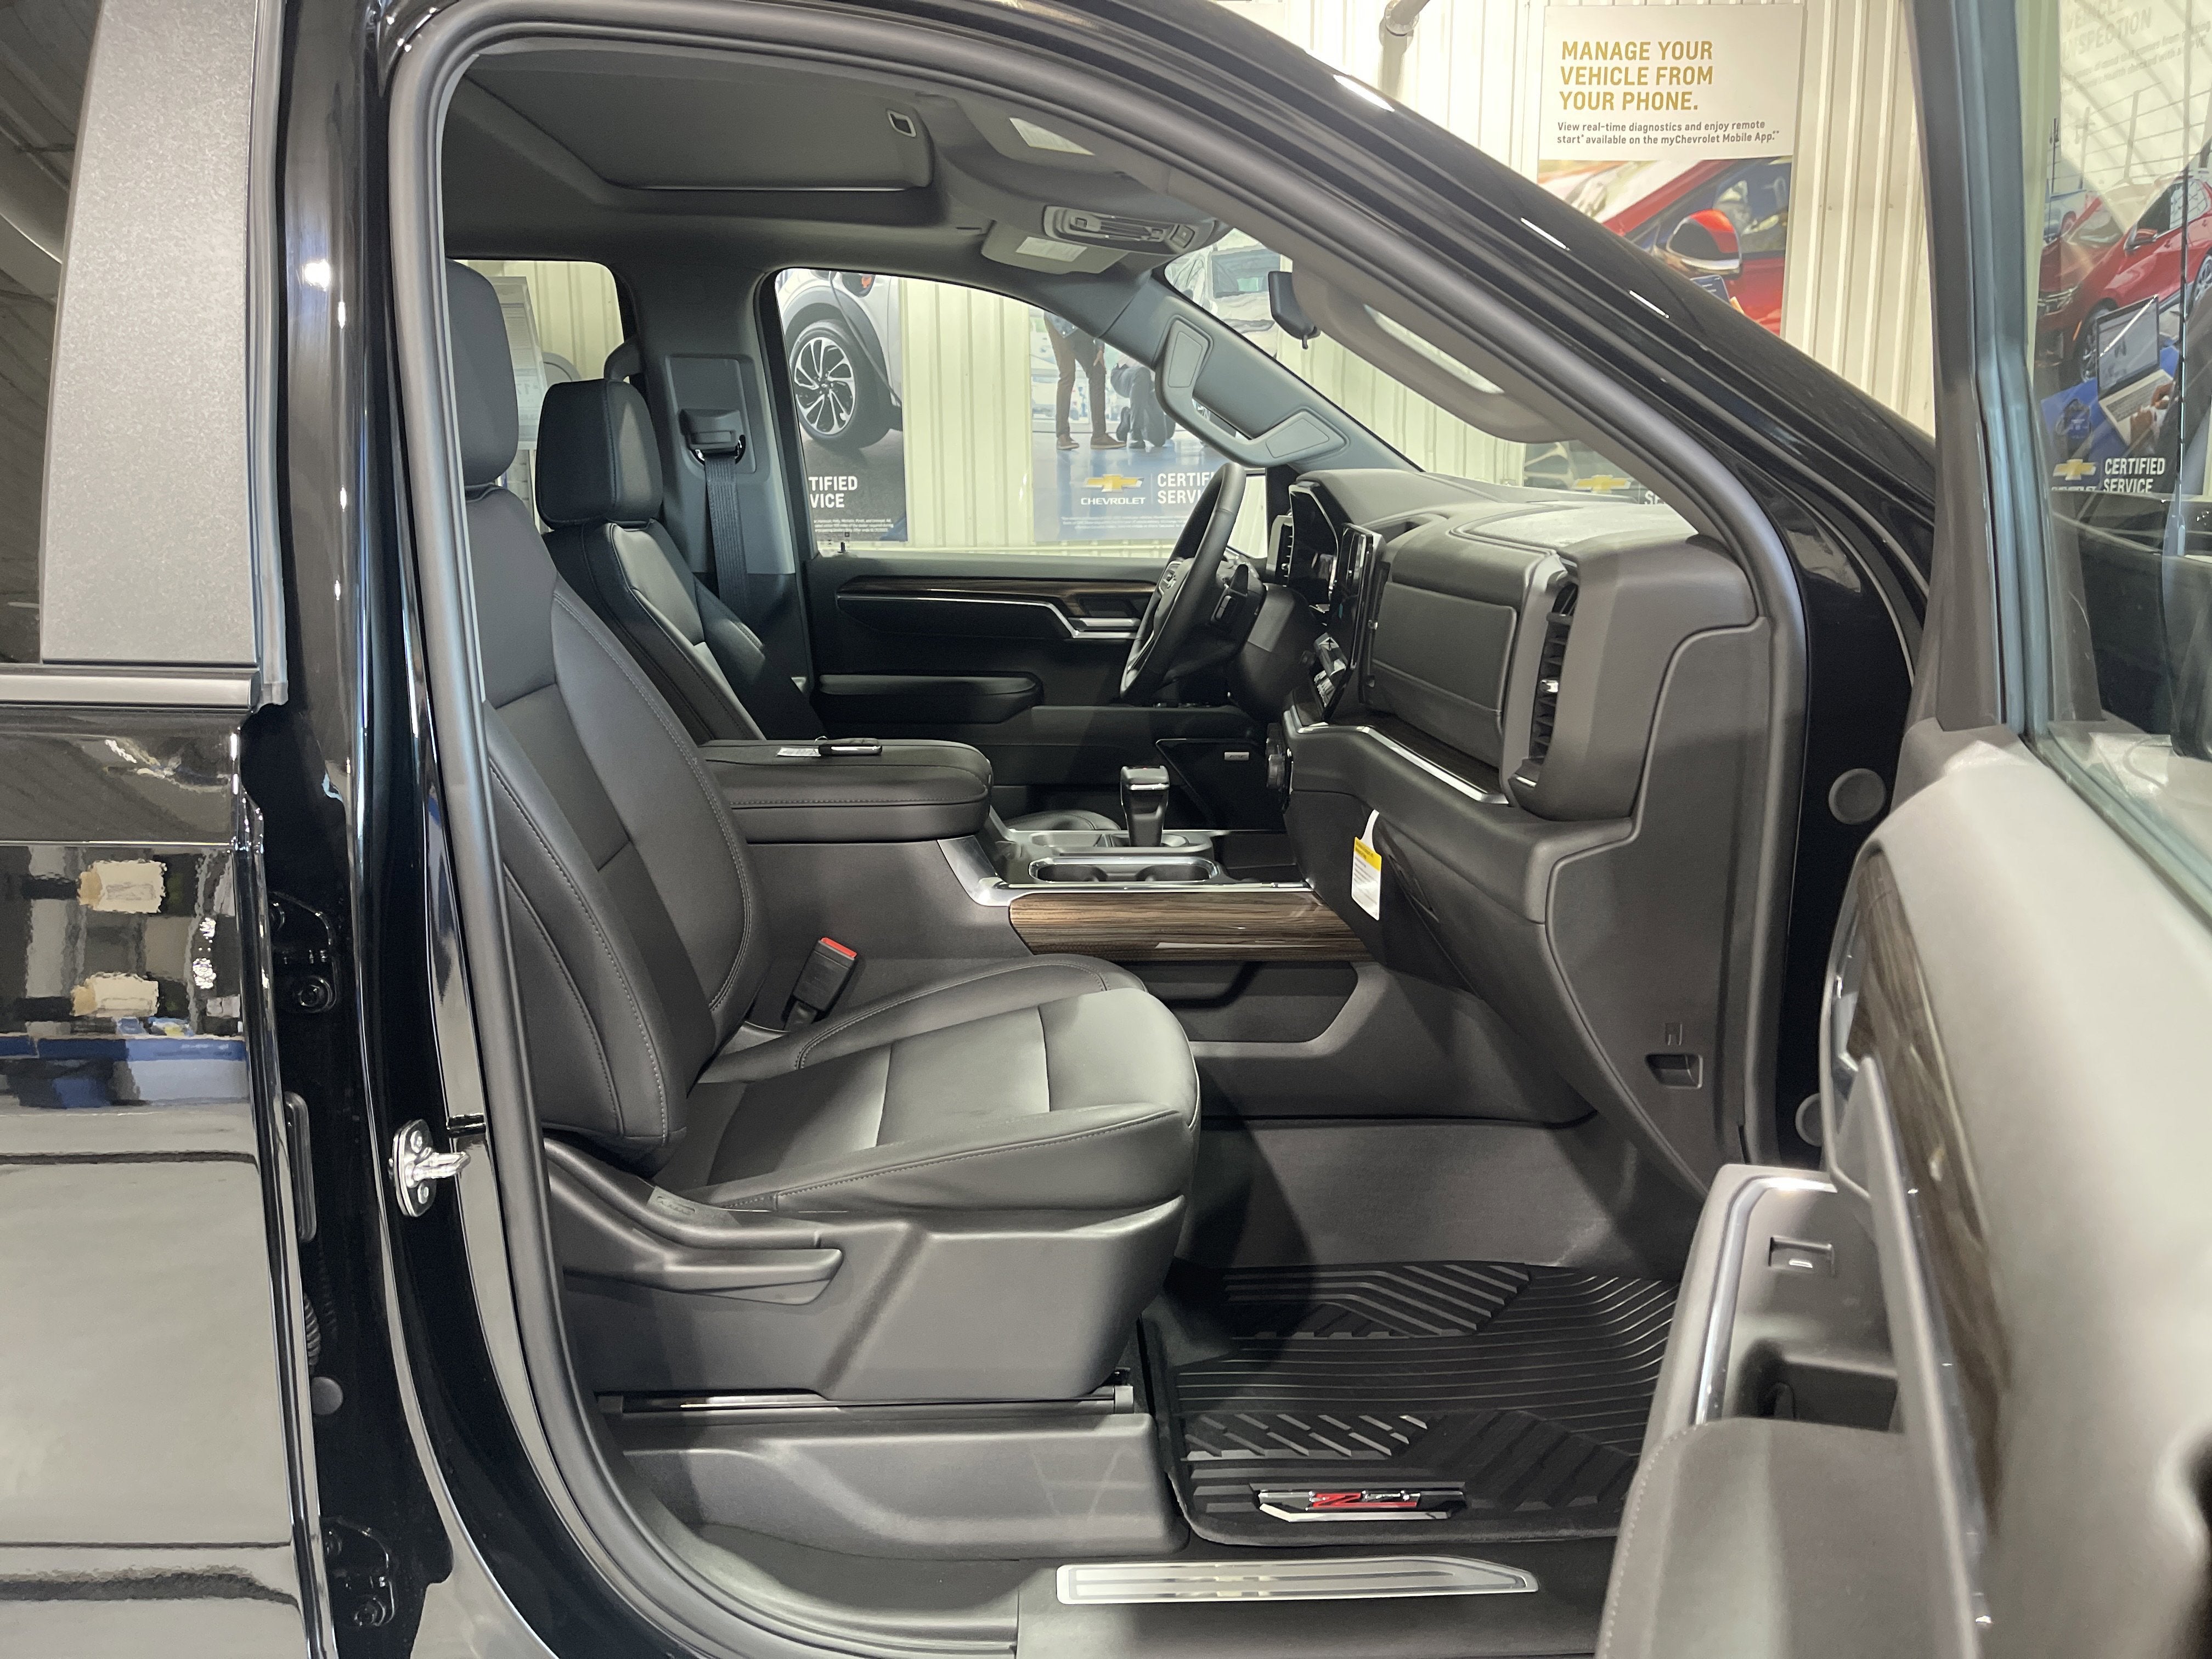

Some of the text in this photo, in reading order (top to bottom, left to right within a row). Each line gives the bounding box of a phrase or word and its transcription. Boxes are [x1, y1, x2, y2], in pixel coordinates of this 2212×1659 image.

[1562, 41, 1713, 60] MANAGE YOUR
[1560, 66, 1713, 86] VEHICLE FROM
[1559, 91, 1698, 110] YOUR PHONE.
[1558, 121, 1765, 133] View real-time diagnostics and enjoy remote
[1586, 135, 1627, 144] available
[1629, 136, 1640, 144] on
[1643, 135, 1658, 144] the
[1661, 134, 1720, 146] myChevrolet
[1723, 133, 1752, 143] Mobile
[2104, 458, 2165, 475] CERTIFIED
[808, 476, 857, 491] TIFIED
[1158, 472, 1215, 487] CERTIF
[2103, 478, 2153, 493] SERVICE
[810, 493, 845, 508] VICE
[1081, 497, 1146, 505] CHEVROLET
[1158, 489, 1201, 504] SERVI
